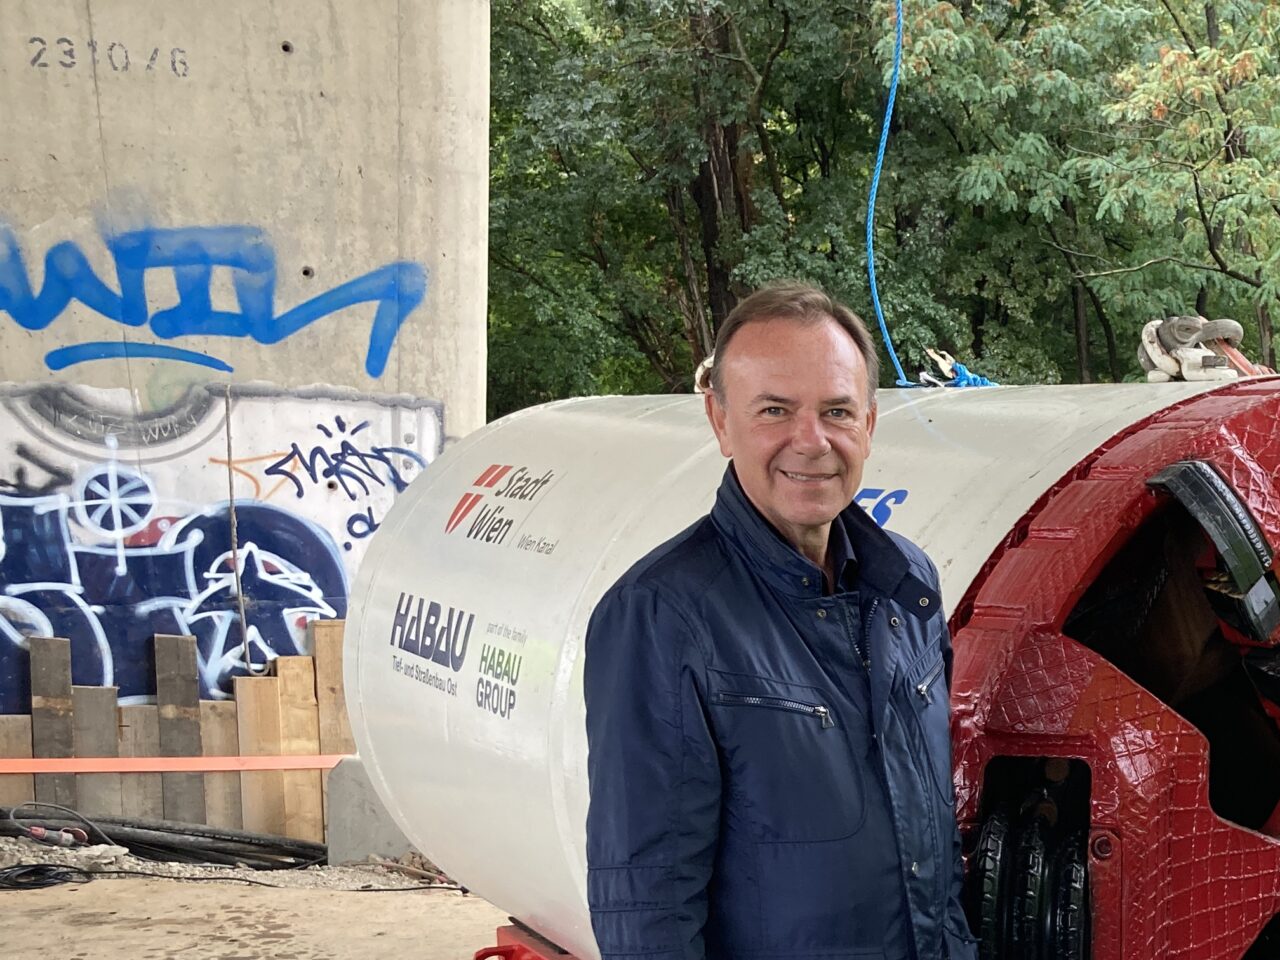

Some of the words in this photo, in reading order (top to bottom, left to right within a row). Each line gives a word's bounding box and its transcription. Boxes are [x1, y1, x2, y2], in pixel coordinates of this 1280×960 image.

[495, 466, 554, 501] Stadt
[466, 503, 514, 544] Wien
[517, 533, 537, 552] Wien
[536, 536, 560, 555] Kanal
[390, 592, 475, 673] HABAU
[403, 663, 415, 679] und
[415, 664, 446, 692] Straßenbau
[446, 677, 458, 697] Ost
[479, 643, 522, 687] HABAU
[476, 677, 516, 720] GROUP
